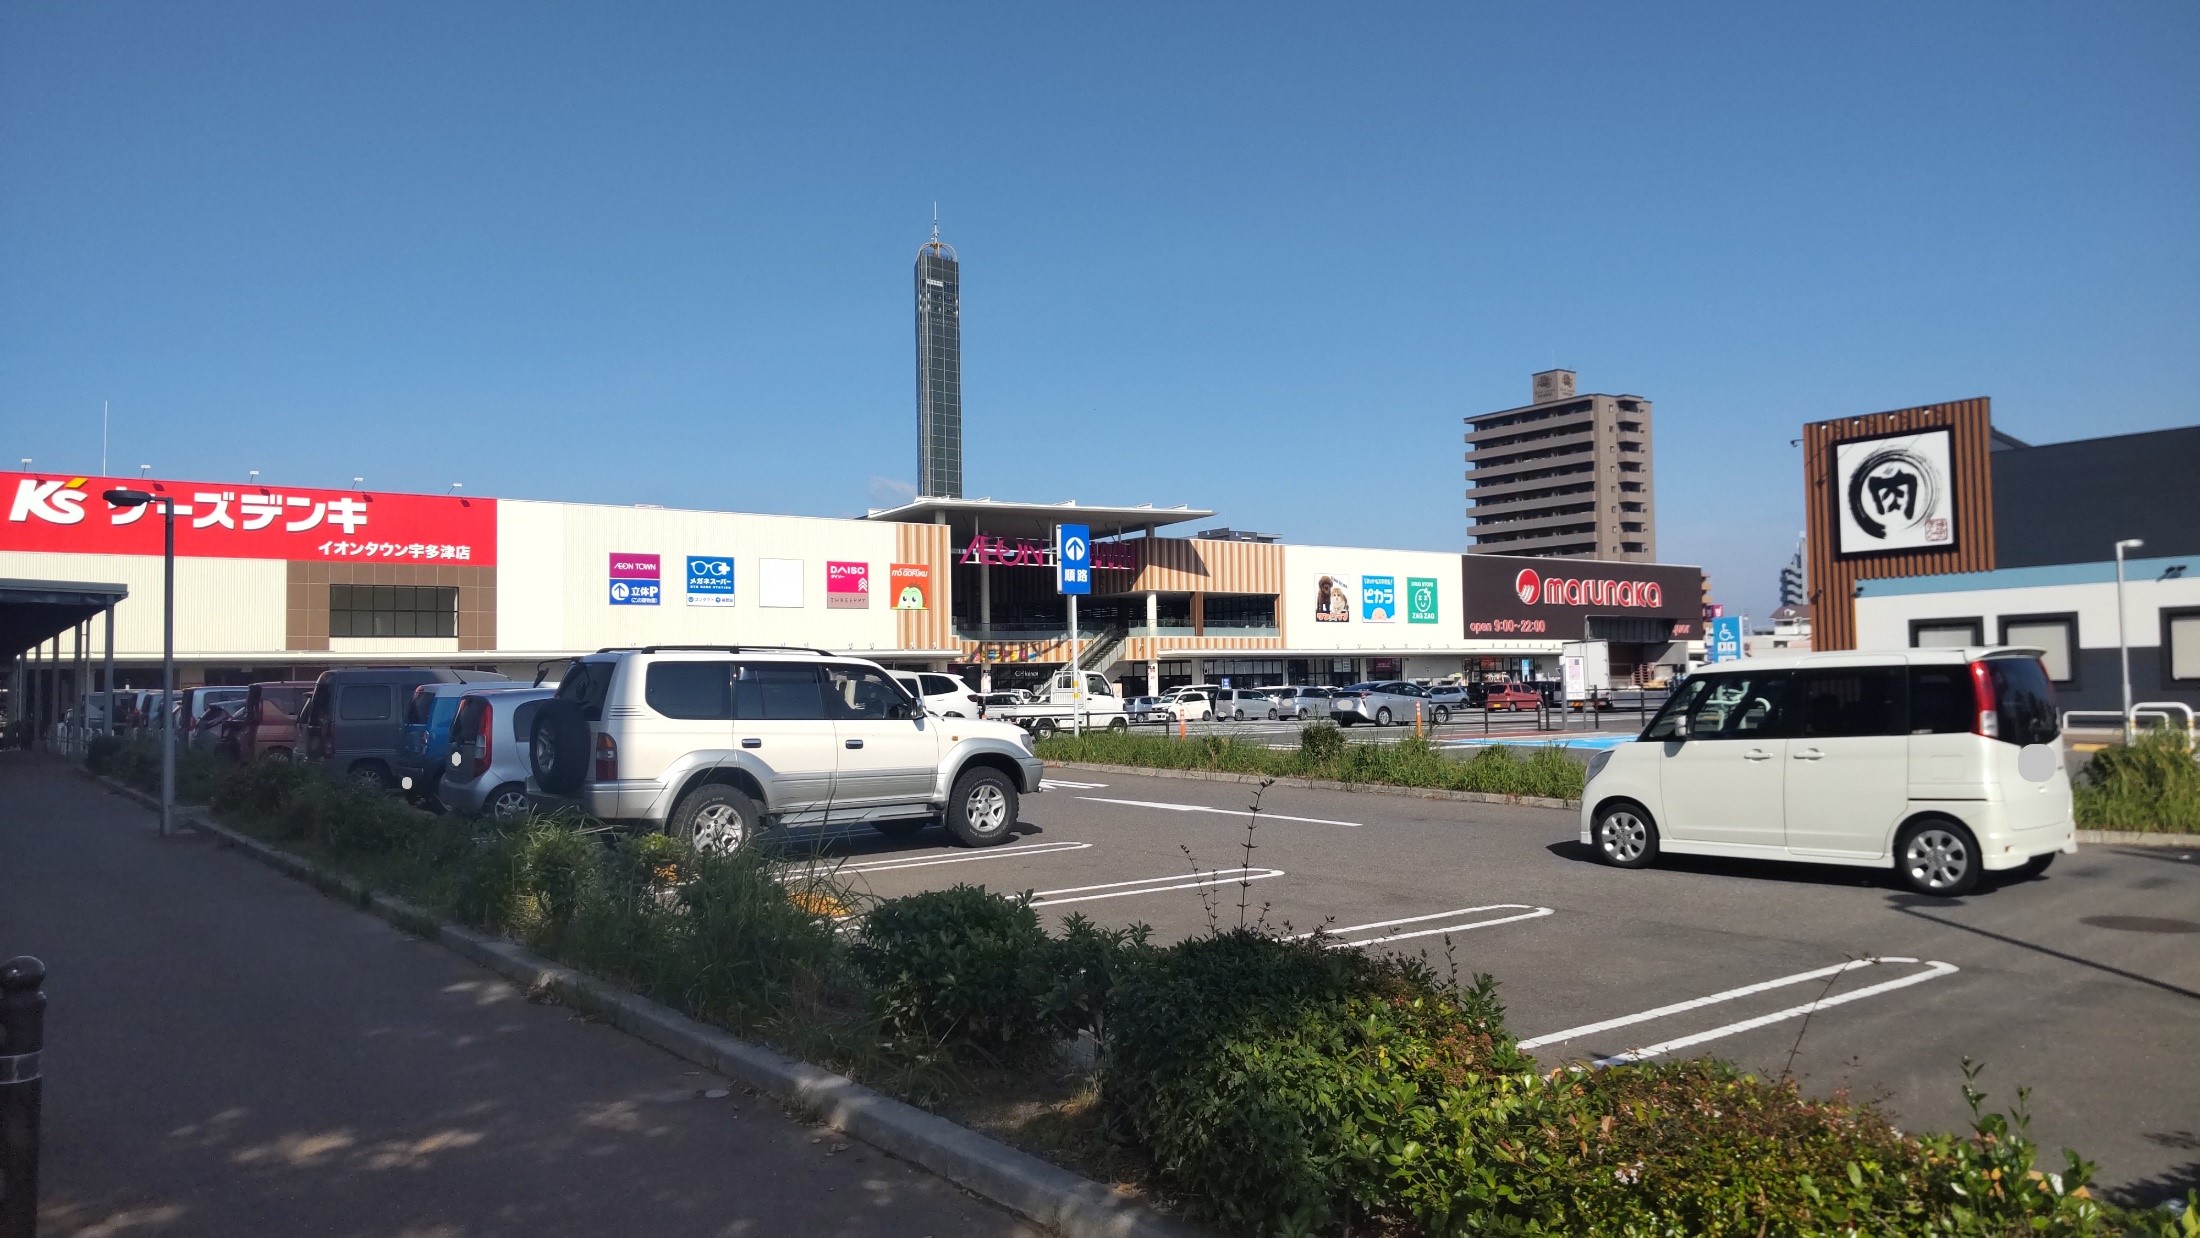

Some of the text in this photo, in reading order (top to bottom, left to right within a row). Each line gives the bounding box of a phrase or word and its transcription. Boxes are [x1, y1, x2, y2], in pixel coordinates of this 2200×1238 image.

[9, 477, 88, 525] K's
[318, 541, 471, 560] イオンタウン宇多津店
[830, 566, 865, 574] DAISO
[1064, 568, 1088, 582] 順路
[631, 585, 659, 597] 立体P
[1363, 588, 1393, 604] ピカラ
[1544, 578, 1663, 608] marunaka
[1470, 622, 1493, 635] open
